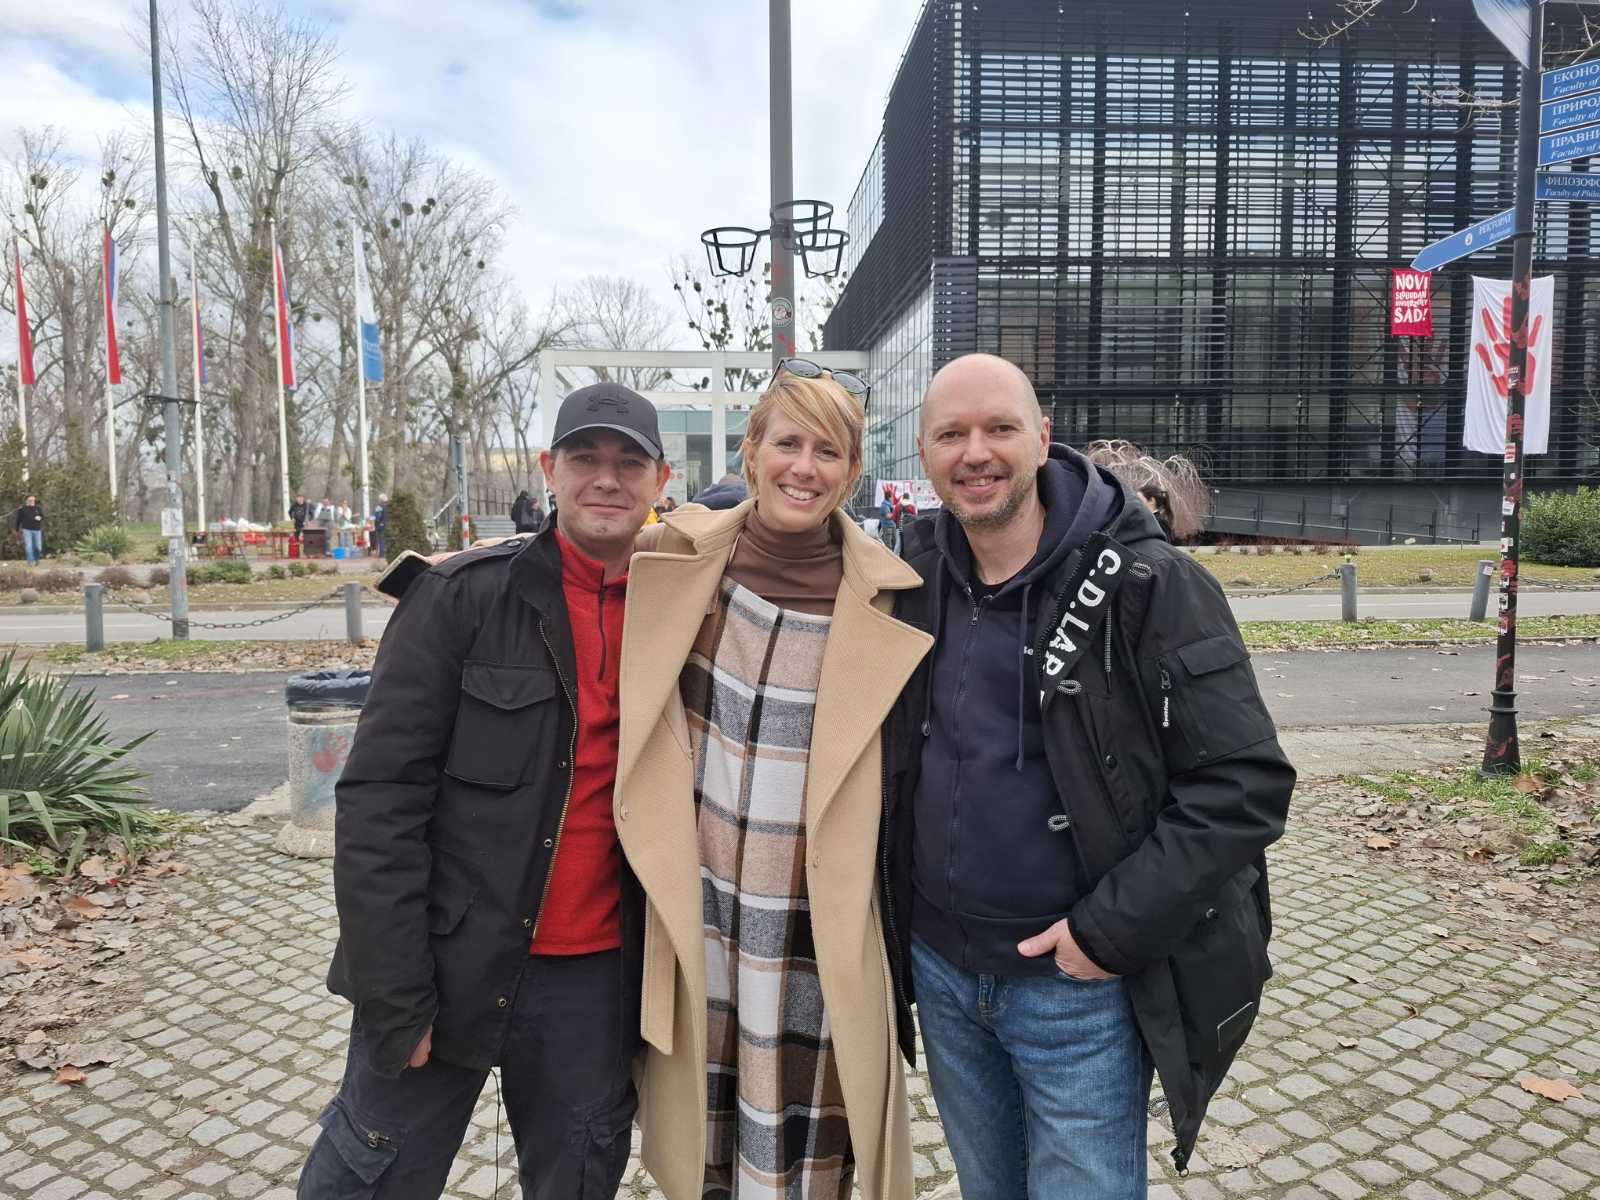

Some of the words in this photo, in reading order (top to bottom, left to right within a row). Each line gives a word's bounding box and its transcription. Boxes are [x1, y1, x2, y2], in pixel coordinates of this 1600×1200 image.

[1553, 64, 1600, 84] ЕКОНО
[1553, 80, 1585, 95] Faculty
[1588, 77, 1600, 87] of
[1552, 113, 1584, 128] Faculty
[1588, 109, 1600, 120] of
[1551, 146, 1583, 160] Faculty
[1545, 188, 1570, 197] Faculty
[1395, 274, 1429, 290] NOVI
[1393, 307, 1429, 324] SAD!
